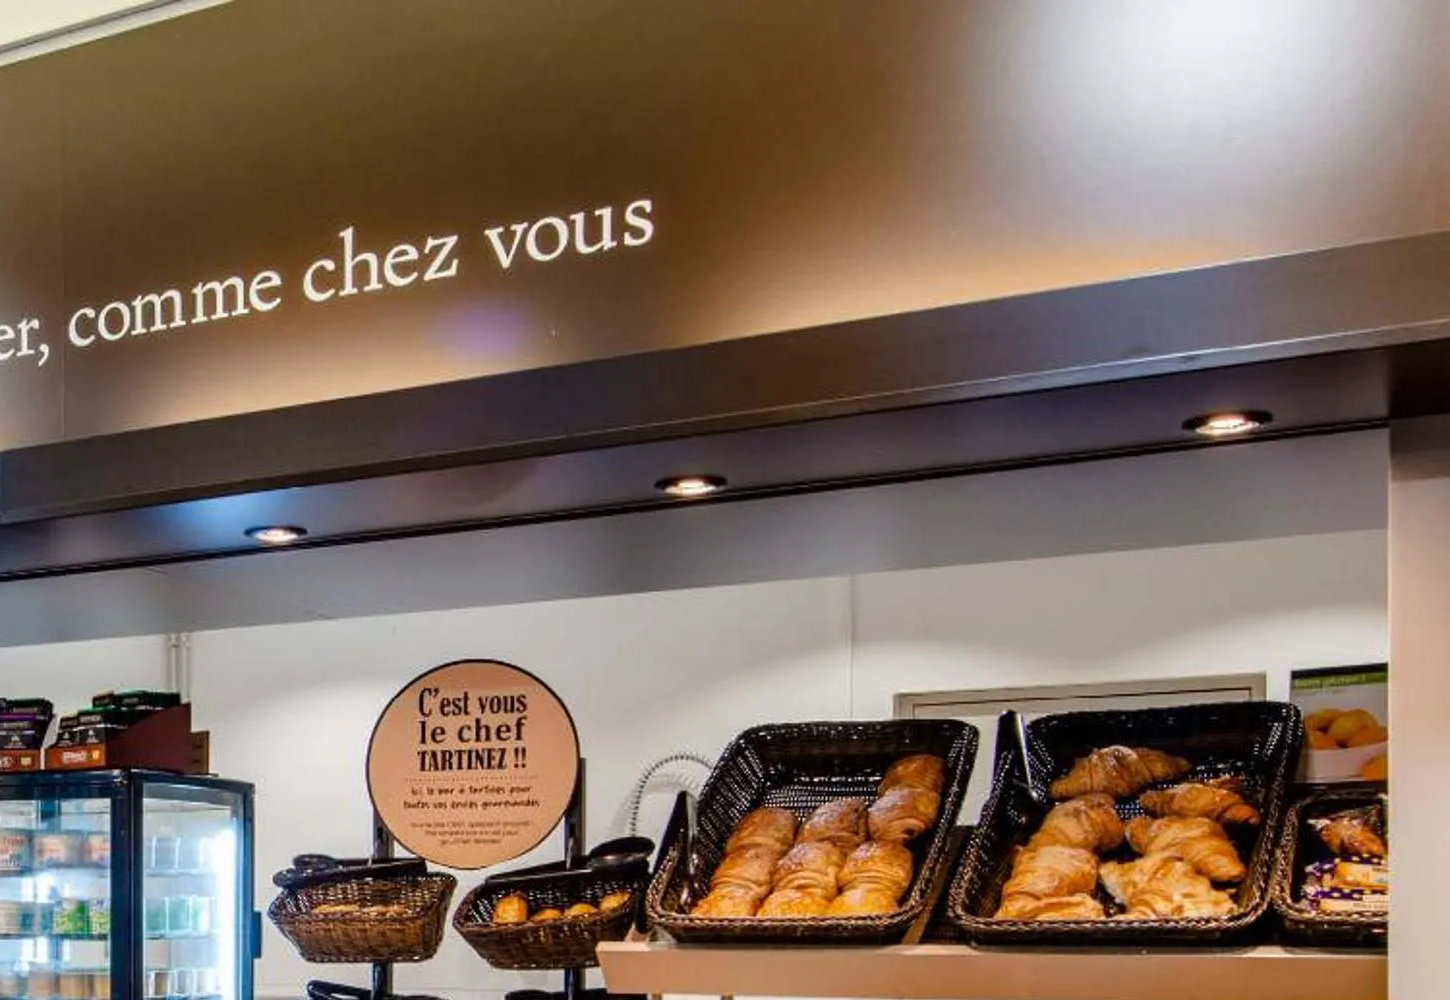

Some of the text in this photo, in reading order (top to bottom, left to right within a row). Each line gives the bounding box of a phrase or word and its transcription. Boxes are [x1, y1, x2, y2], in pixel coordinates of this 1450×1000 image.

[68, 269, 283, 348] comme
[302, 226, 459, 302] chez
[484, 199, 655, 269] vous
[418, 687, 527, 718] C'est vous
[418, 716, 528, 745] le chef
[417, 748, 507, 772] TARTINEZ
